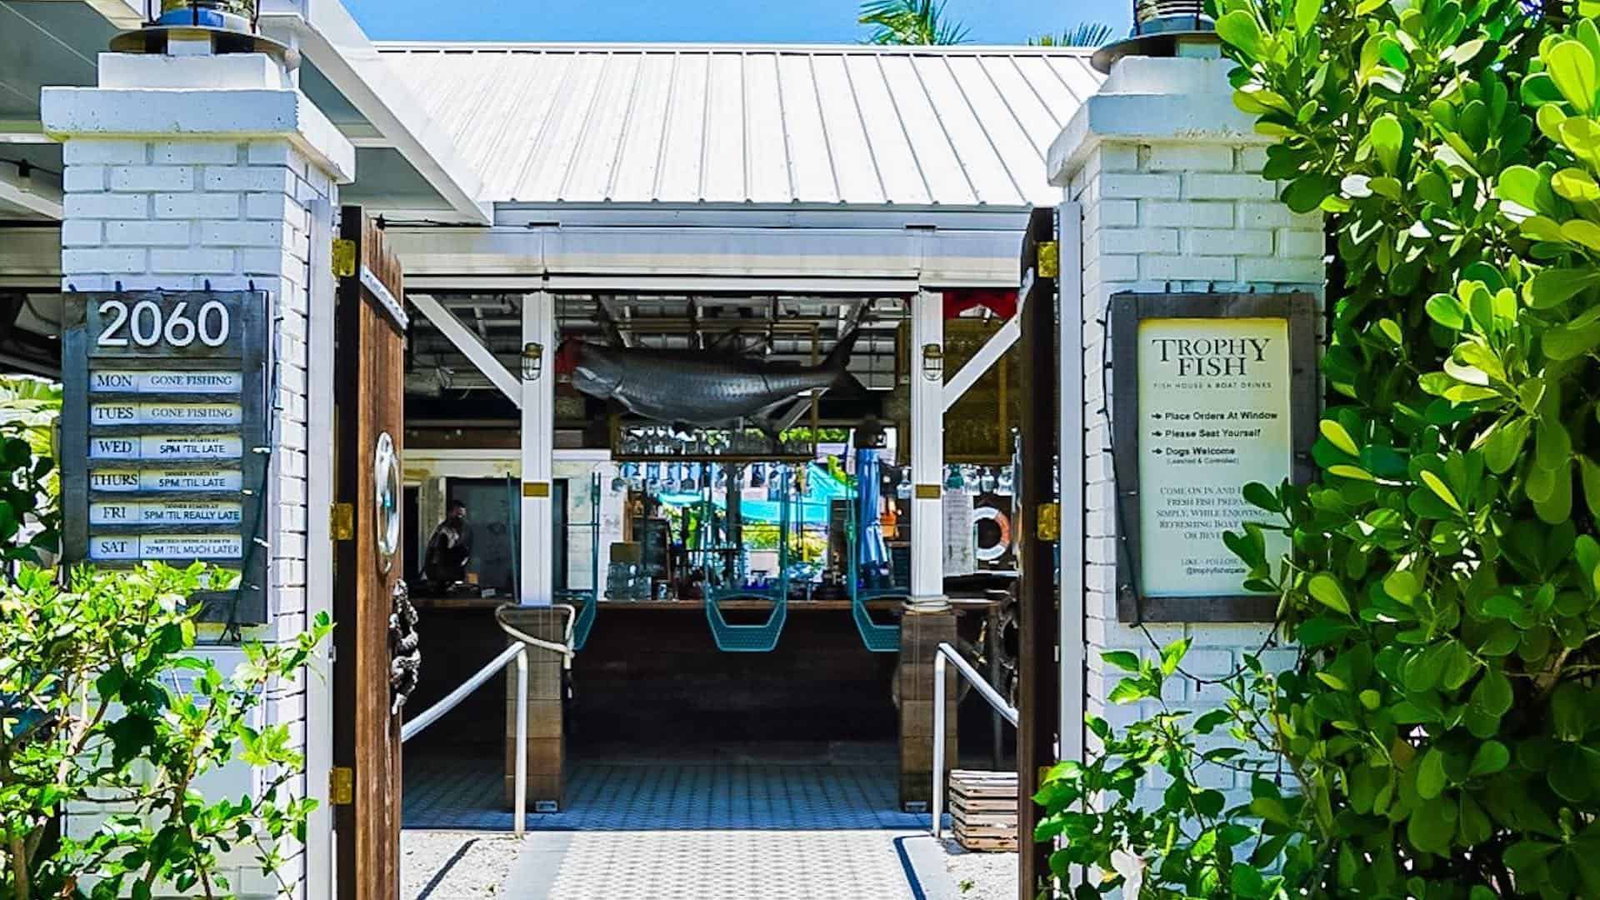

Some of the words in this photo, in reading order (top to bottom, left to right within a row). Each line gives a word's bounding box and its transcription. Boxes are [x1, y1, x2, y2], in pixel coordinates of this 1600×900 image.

[97, 300, 230, 347] 2060
[1152, 338, 1271, 362] TROPHY
[1178, 357, 1248, 377] FISH
[97, 375, 133, 387] MON
[151, 376, 185, 386] GONE
[187, 376, 232, 386] FISHING
[95, 408, 134, 419] TUES
[152, 408, 185, 418] GONE
[187, 408, 233, 418] FISHING
[1164, 412, 1190, 420] Place
[1193, 412, 1225, 420] Orders
[1227, 412, 1238, 420] At
[1240, 412, 1278, 420] Window
[1164, 429, 1197, 437] Please
[1199, 429, 1220, 437] Seat
[1221, 429, 1261, 437] Yourself
[99, 441, 132, 453] WED
[160, 444, 180, 454] 5PM
[203, 444, 225, 453] LATE
[1165, 447, 1189, 457] Dogs
[92, 474, 138, 485] THURS
[159, 478, 180, 487] 5PM
[203, 478, 226, 487] LATE
[1167, 498, 1194, 506] FRESH
[1196, 498, 1215, 506] FISH
[103, 507, 126, 518] FRI
[144, 511, 163, 520] 5PM
[184, 511, 216, 520] REALLY
[217, 511, 240, 520] LATE
[1156, 509, 1189, 518] SIMPLY,
[1190, 509, 1220, 517] WHILE
[1159, 520, 1213, 528] REFRESHING
[1214, 520, 1239, 528] BOAT
[101, 542, 128, 554] SAT
[145, 545, 164, 554] 2PM
[184, 545, 210, 554] MUCH
[212, 545, 240, 554] LATER
[1180, 558, 1198, 566] LIKE
